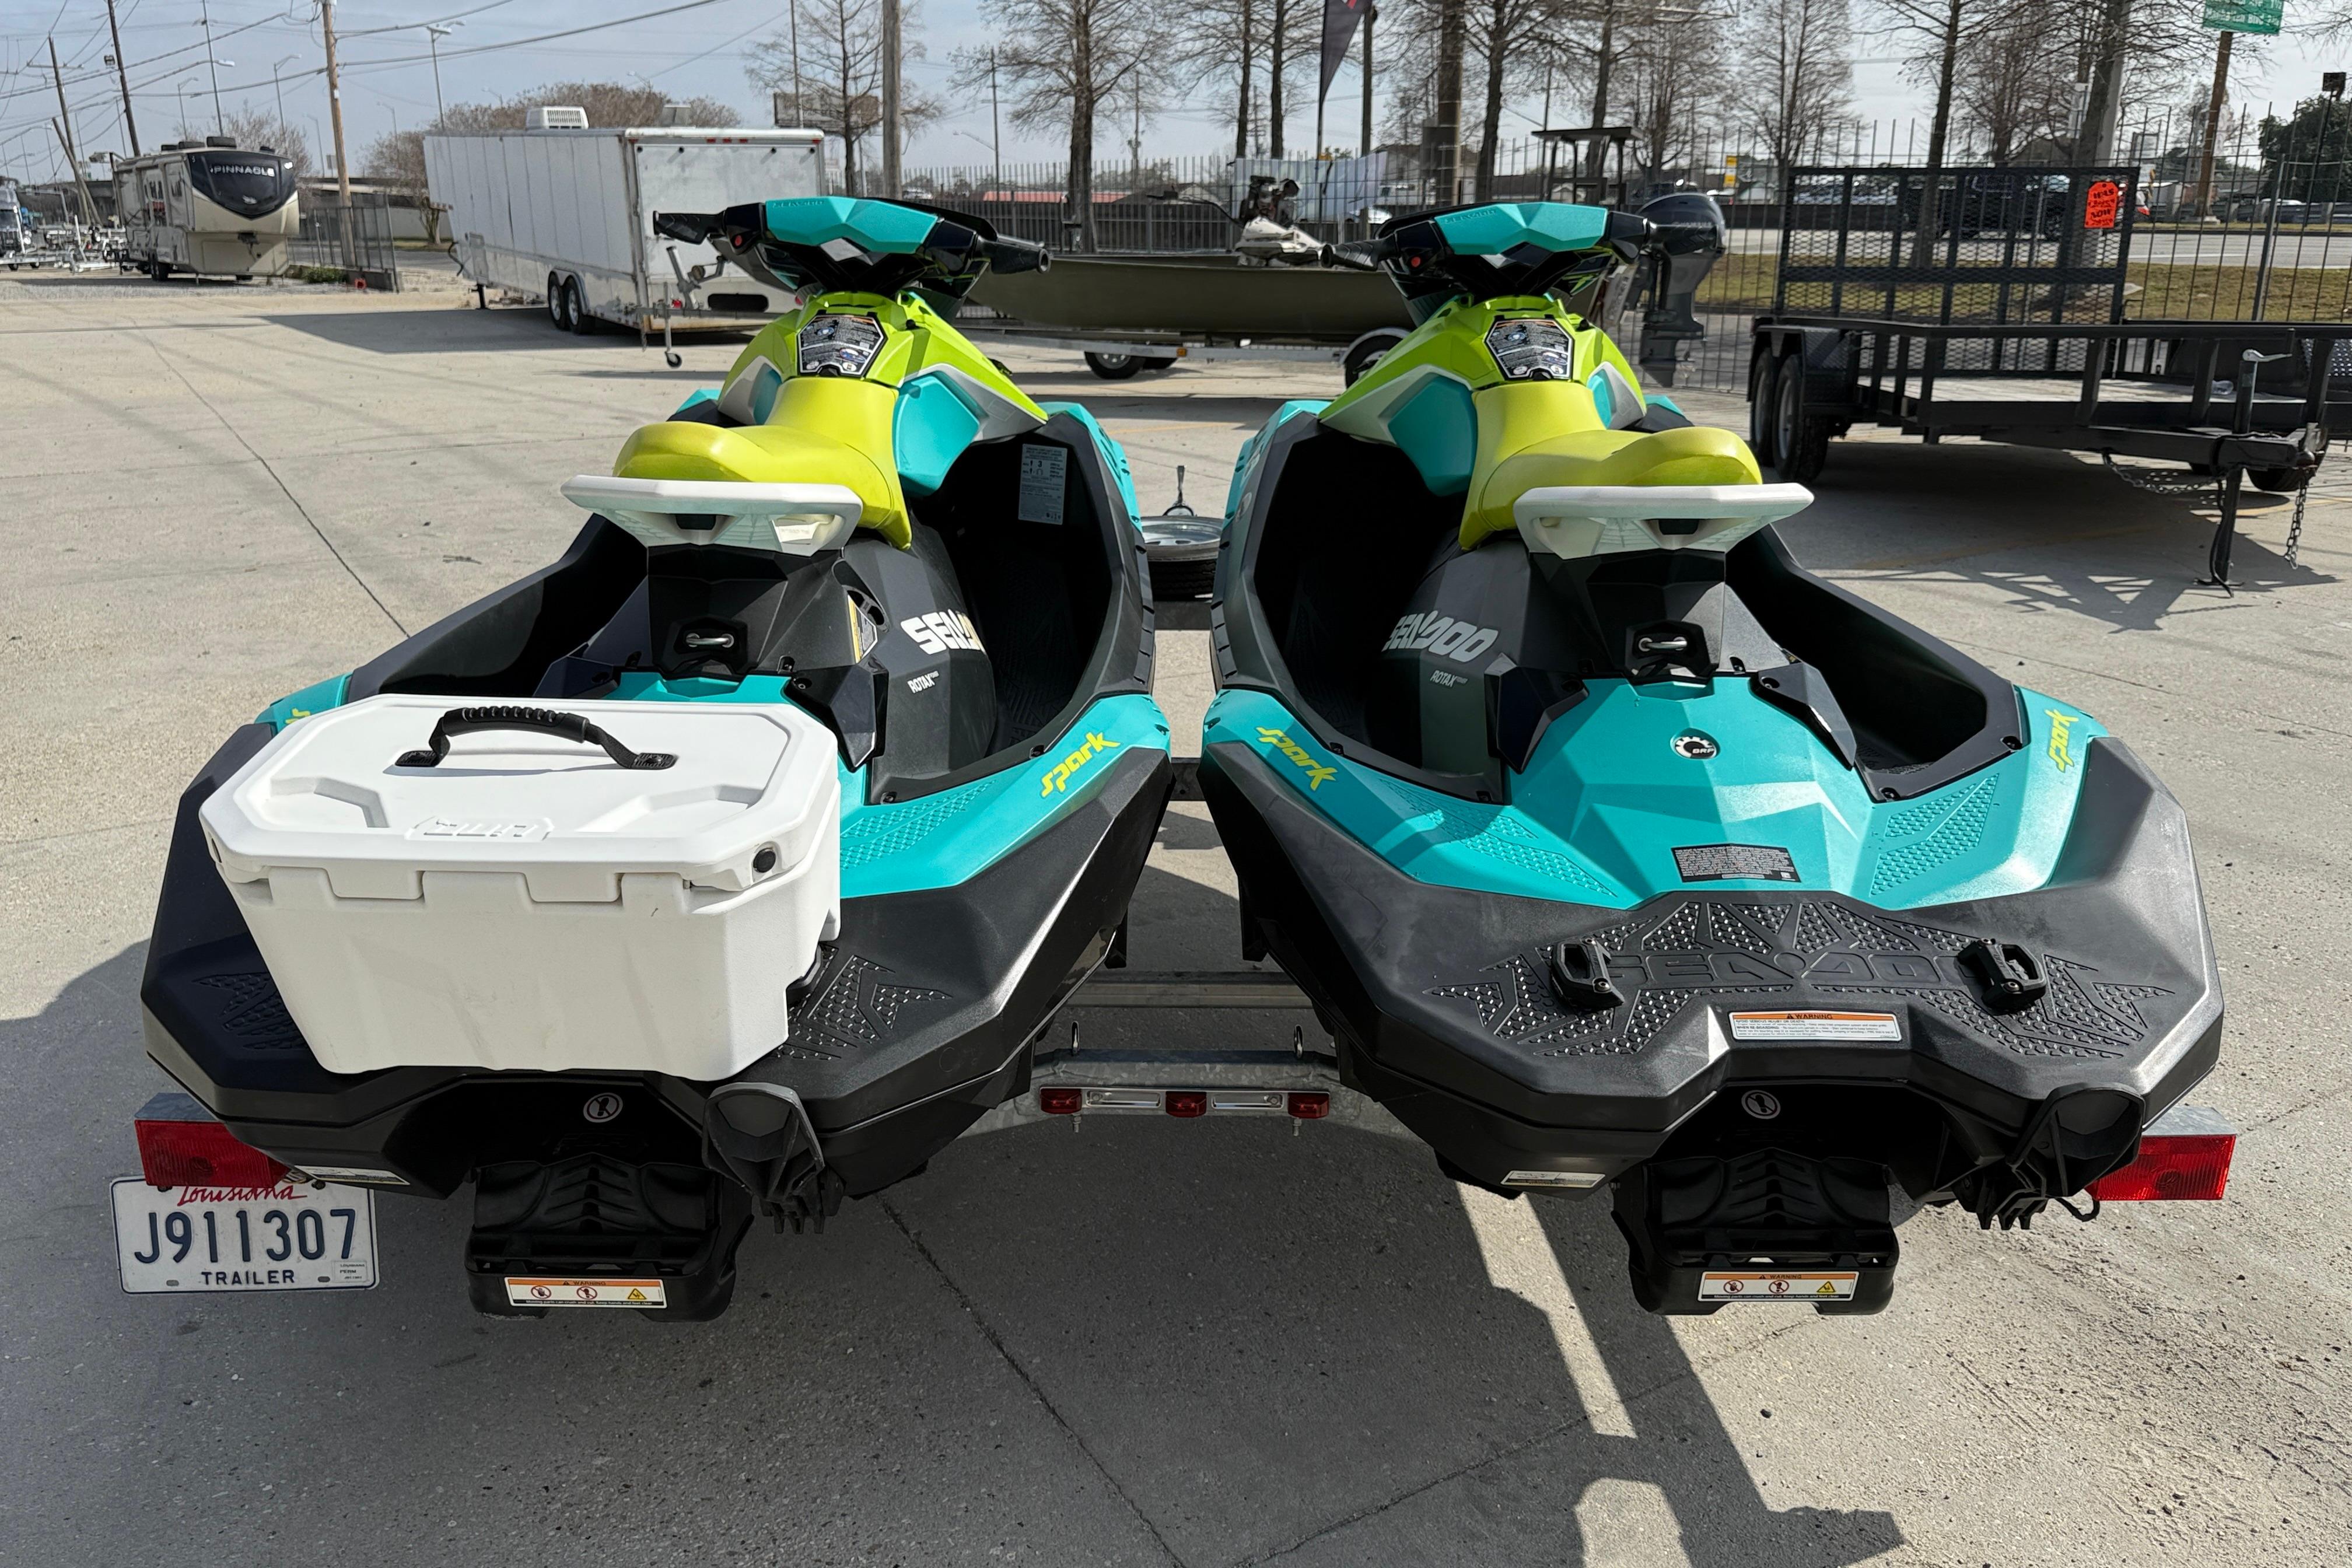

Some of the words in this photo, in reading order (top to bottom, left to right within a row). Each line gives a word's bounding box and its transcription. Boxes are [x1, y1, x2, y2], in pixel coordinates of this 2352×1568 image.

[214, 165, 275, 177] PINNACLE
[907, 673, 935, 694] ROTAX
[1430, 670, 1457, 687] ROTAX
[2044, 709, 2079, 773] spark
[1042, 732, 1121, 797] spark
[1256, 727, 1338, 791] spark
[177, 1185, 307, 1206] Louisiana
[134, 1208, 356, 1264] J911307
[201, 1270, 295, 1286] TRAILER
